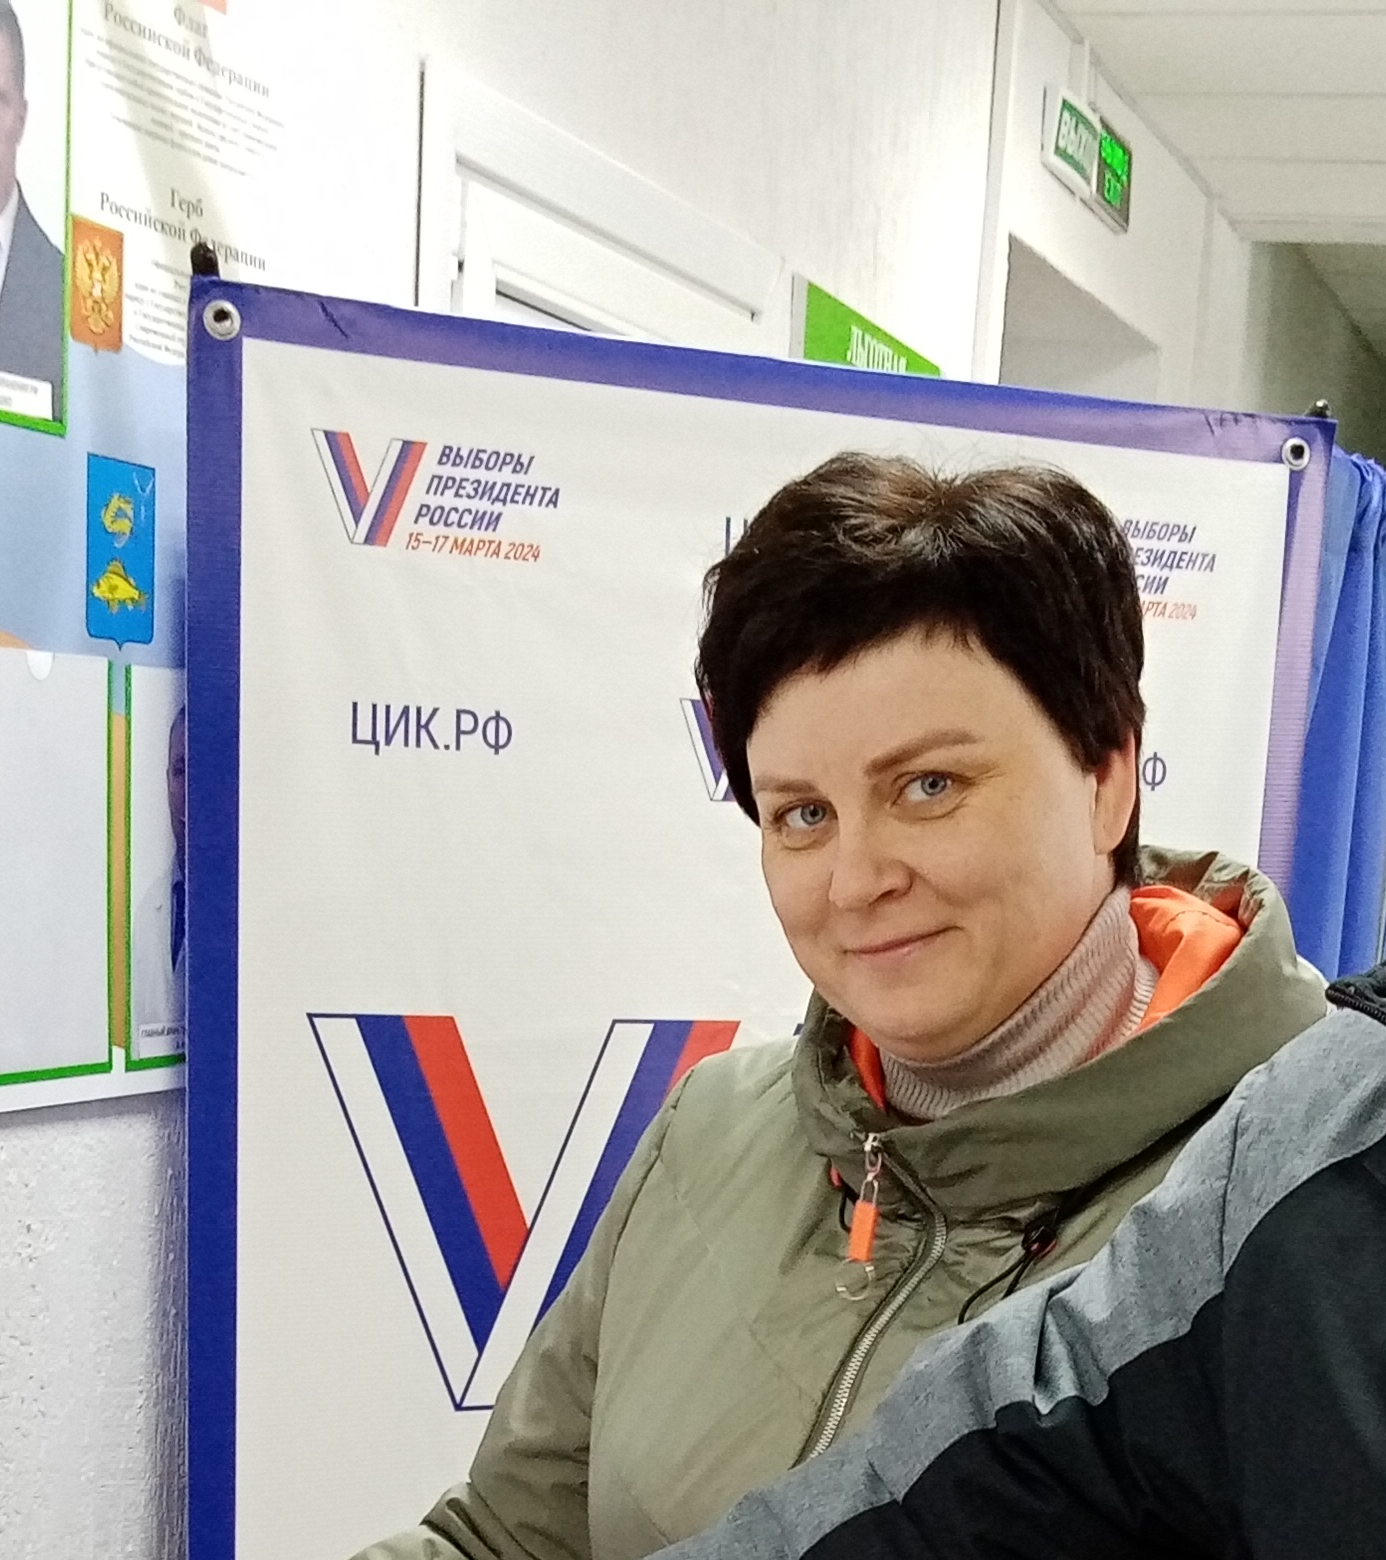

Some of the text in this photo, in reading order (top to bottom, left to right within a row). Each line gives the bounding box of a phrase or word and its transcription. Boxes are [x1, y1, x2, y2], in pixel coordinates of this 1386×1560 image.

[103, 2, 192, 61] Российской
[194, 46, 270, 99] Федерации
[99, 191, 187, 245] Российской
[170, 187, 204, 219] Герб
[437, 445, 535, 476] ВЫБОРЫ
[425, 474, 561, 509] ПРЕЗИДЕНТА
[414, 503, 503, 533] РОССИИ
[449, 538, 502, 560] МАРТА
[504, 542, 541, 563] 2024
[1133, 547, 1217, 573] ЕЗИДЕНТА
[350, 700, 513, 756] ЦИК.РФ
